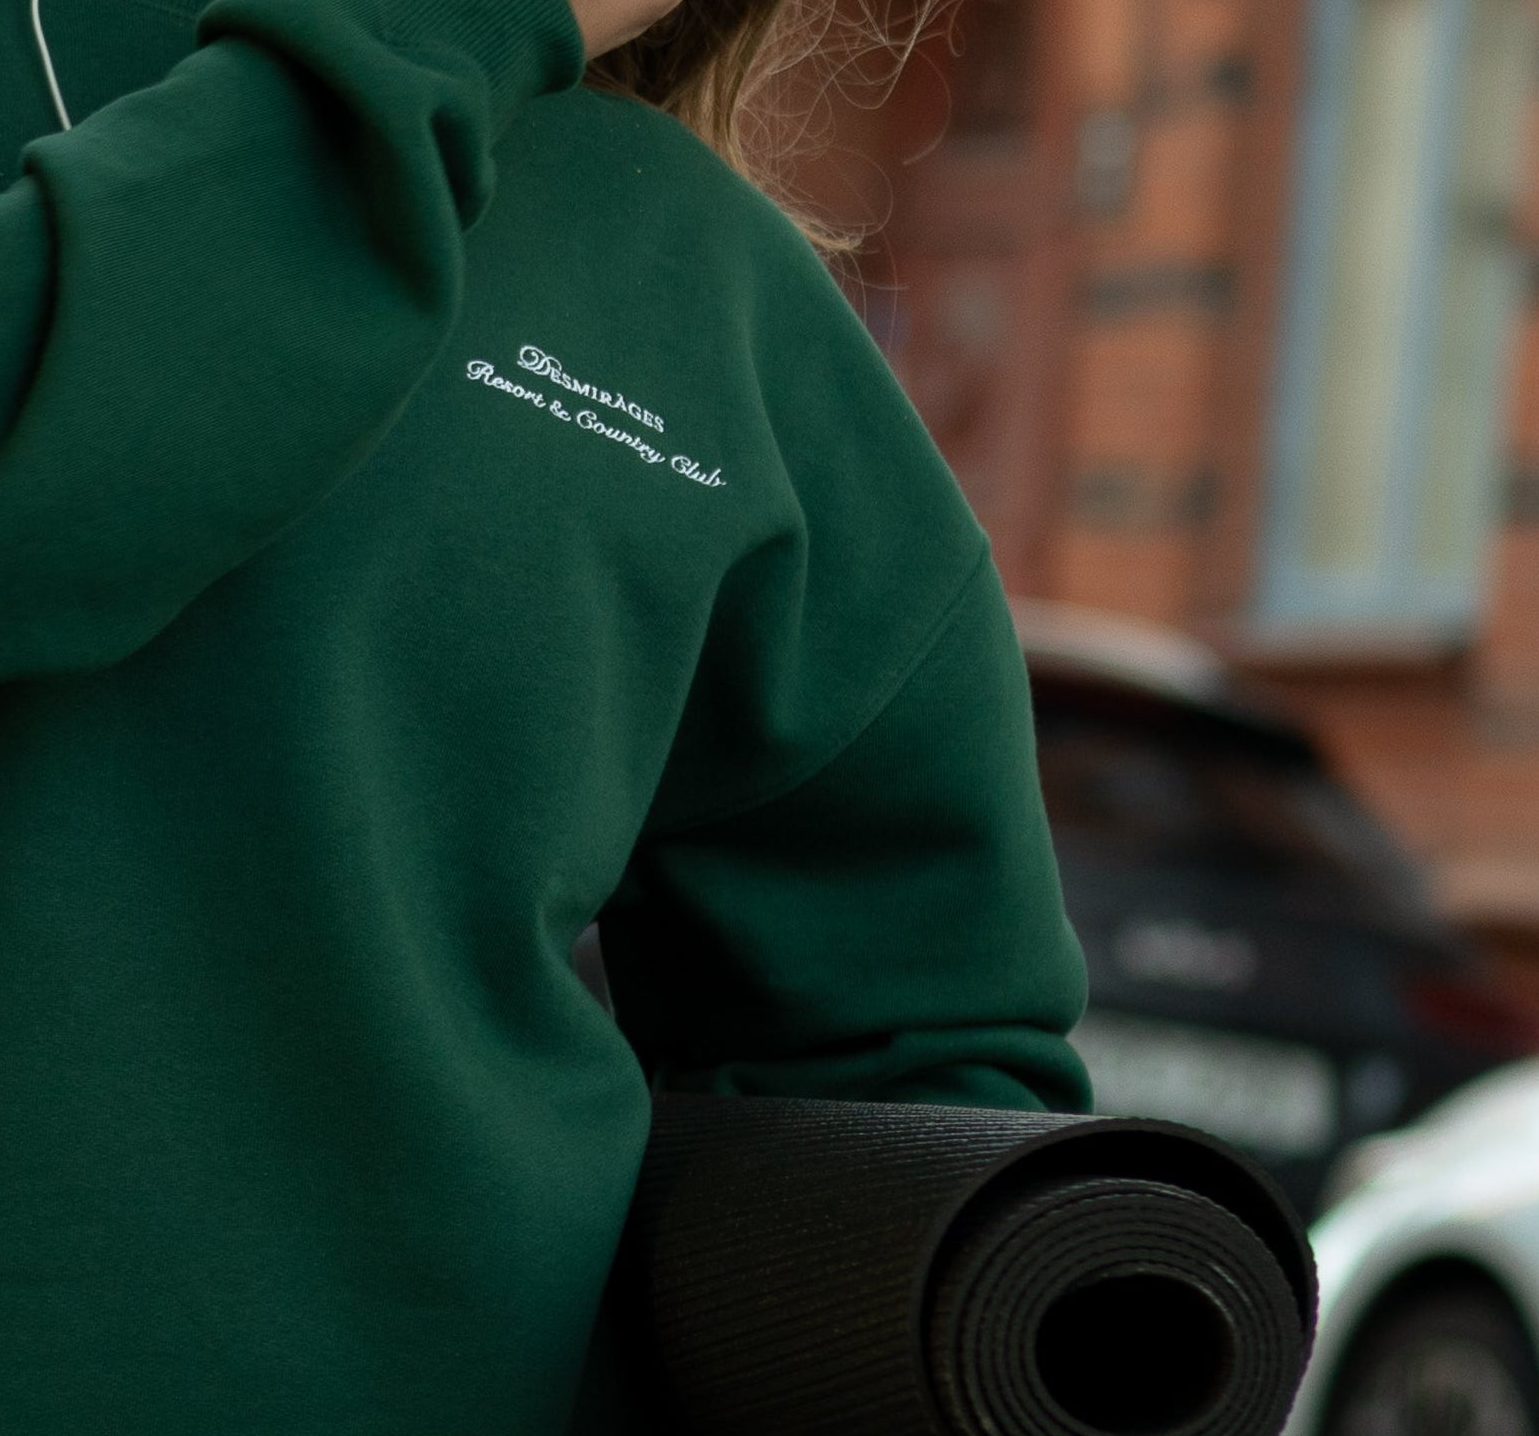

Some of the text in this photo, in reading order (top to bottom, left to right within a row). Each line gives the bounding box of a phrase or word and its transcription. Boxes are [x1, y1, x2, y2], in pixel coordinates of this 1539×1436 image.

[466, 360, 727, 487] Resort & Country Club
